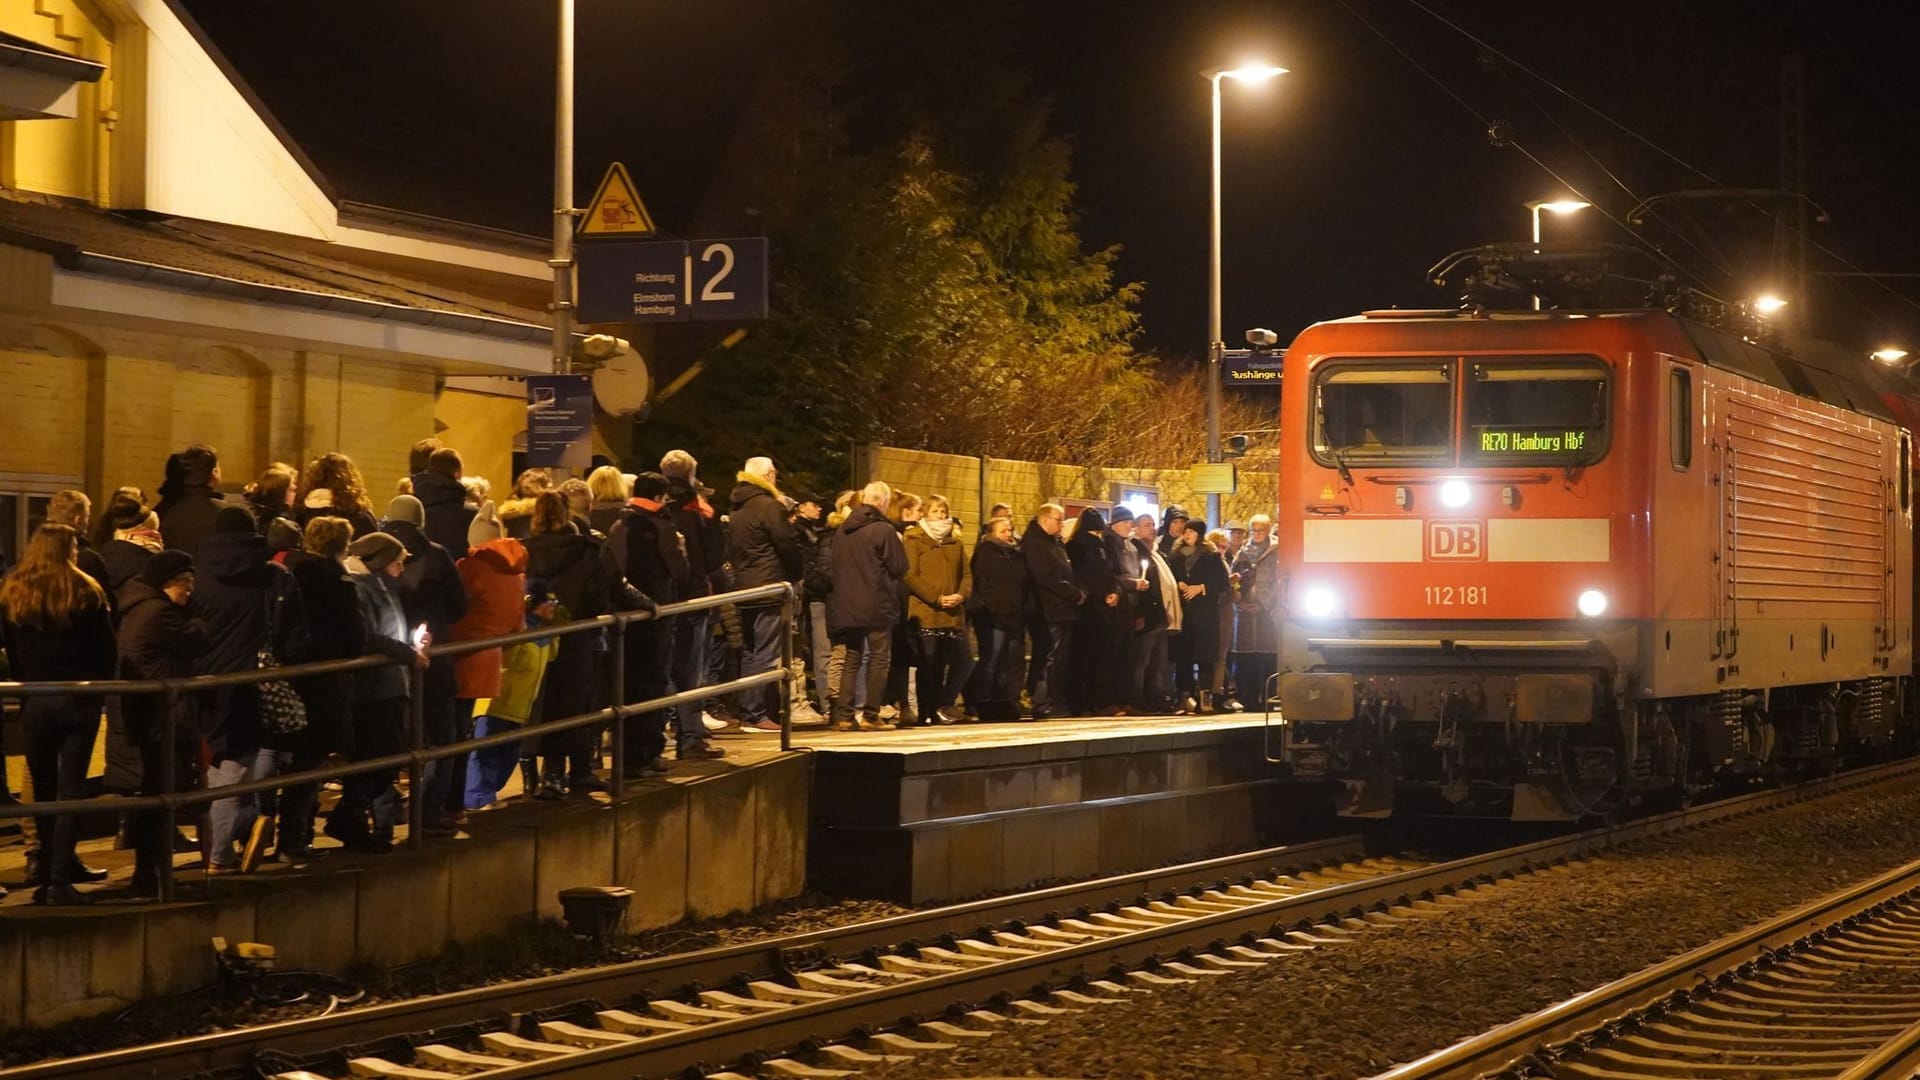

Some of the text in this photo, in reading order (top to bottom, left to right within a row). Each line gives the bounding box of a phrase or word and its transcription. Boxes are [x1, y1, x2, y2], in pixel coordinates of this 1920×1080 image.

[635, 273, 676, 284] Richtung
[702, 243, 735, 301] 2
[633, 293, 676, 303] Elmshorn
[634, 305, 676, 316] Hamburg
[1481, 431, 1585, 451] RE70 Hamburg Hbf
[1434, 526, 1477, 555] DB
[1424, 586, 1487, 605] 112 181
